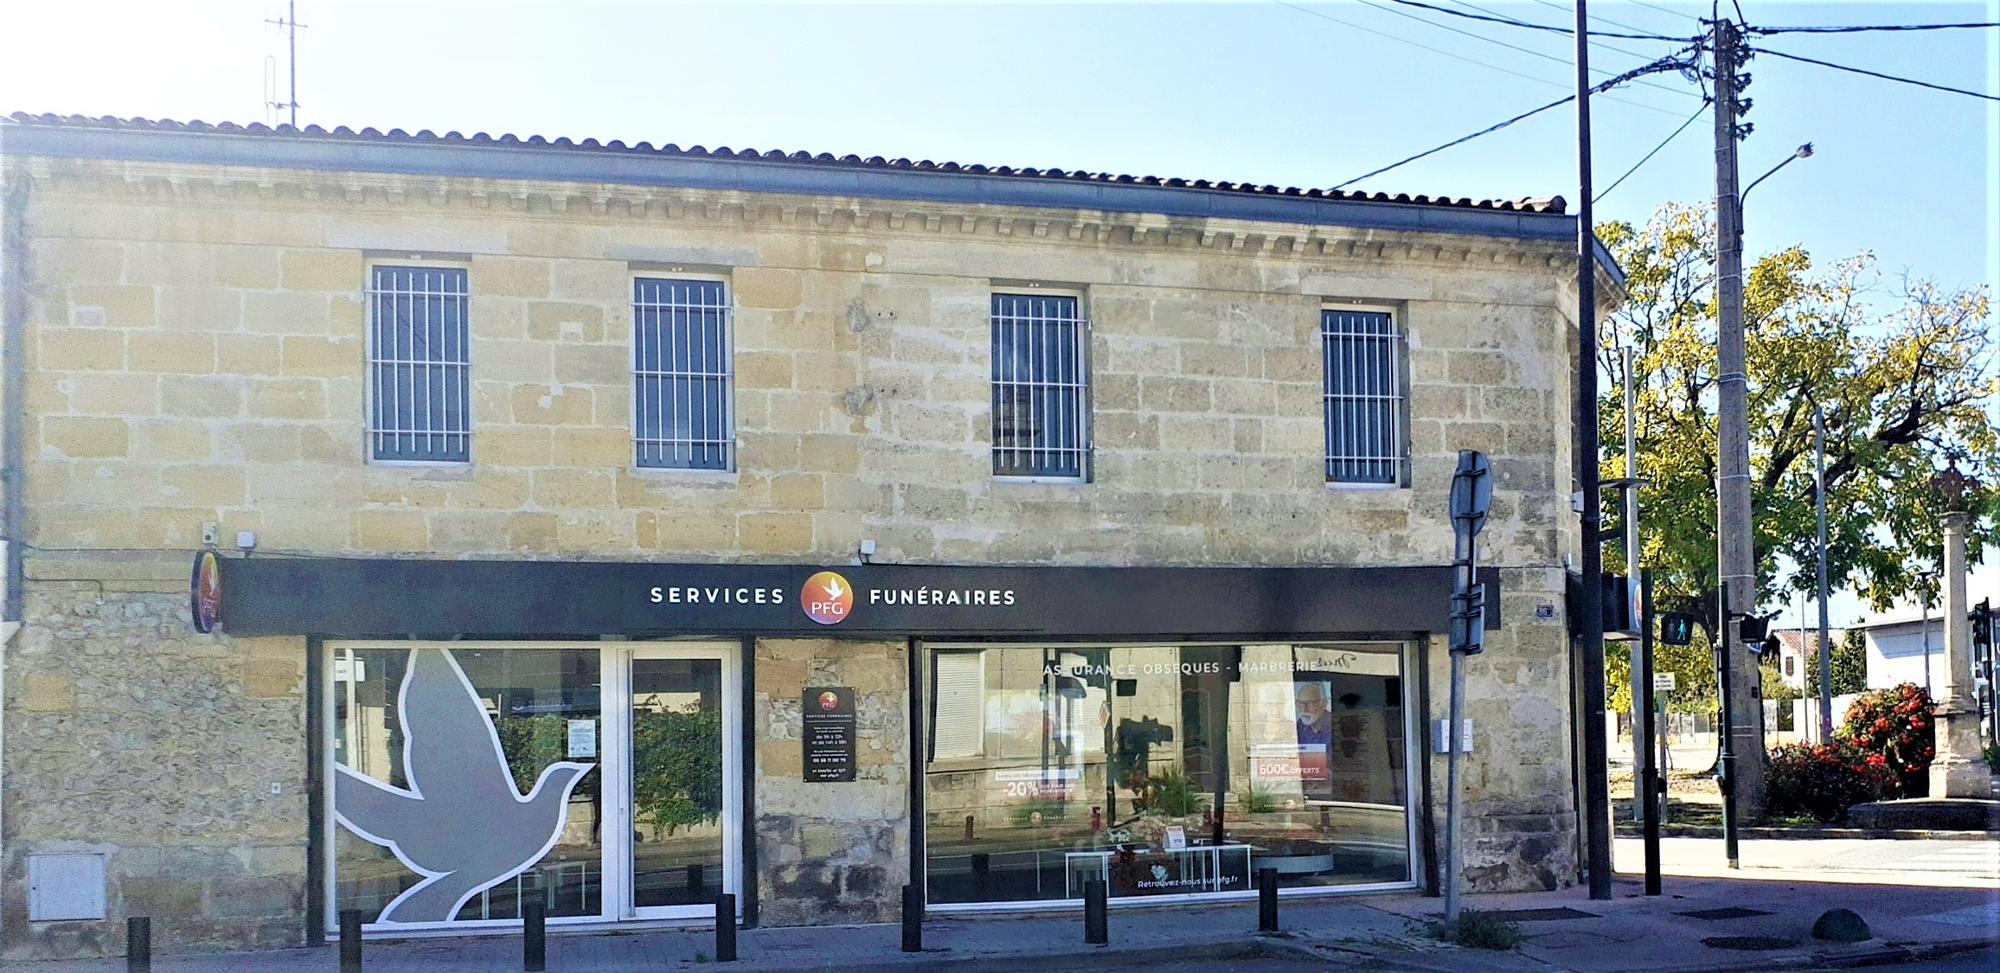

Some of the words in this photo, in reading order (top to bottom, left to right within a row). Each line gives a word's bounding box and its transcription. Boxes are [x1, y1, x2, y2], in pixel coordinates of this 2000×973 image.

[649, 586, 784, 604] SERVICES
[869, 586, 1016, 605] FUNÉRAIRES
[811, 602, 845, 615] PFG
[1043, 664, 1136, 676] ASURANCE
[1143, 662, 1220, 675] OBSEQUES
[1238, 661, 1318, 673] MARBRERIE
[1260, 763, 1288, 775] 600€
[1003, 781, 1039, 797] -20%
[1137, 878, 1201, 889] Retrouvez-nous
